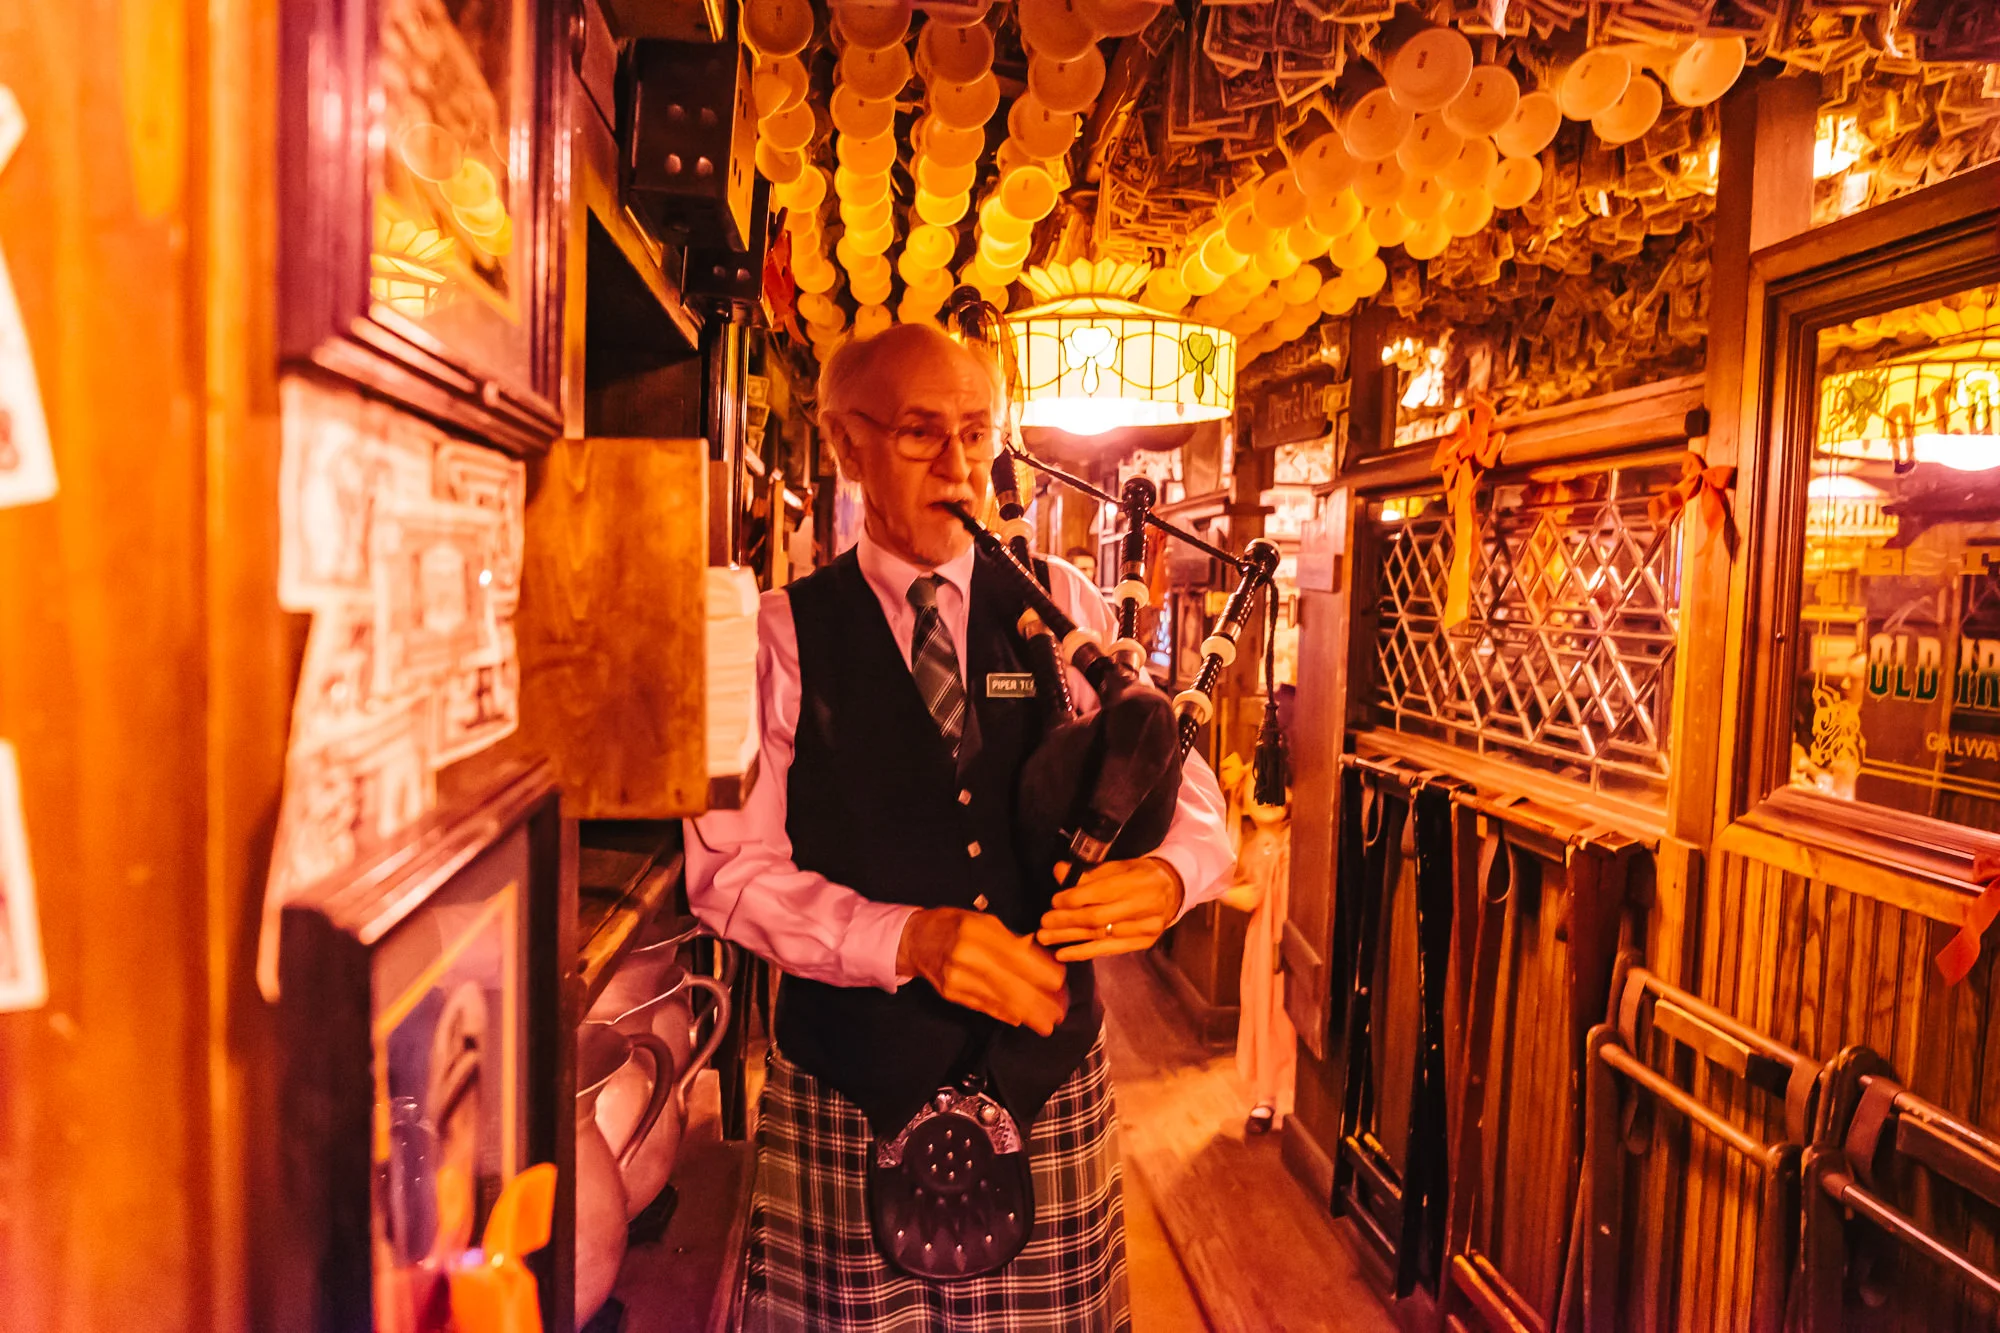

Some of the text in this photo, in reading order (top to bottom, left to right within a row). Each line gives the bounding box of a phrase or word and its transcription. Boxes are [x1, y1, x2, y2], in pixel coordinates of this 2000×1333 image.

[1867, 633, 1943, 704] OLD
[991, 679, 1018, 691] PIPER
[1925, 731, 2000, 762] GALWA
